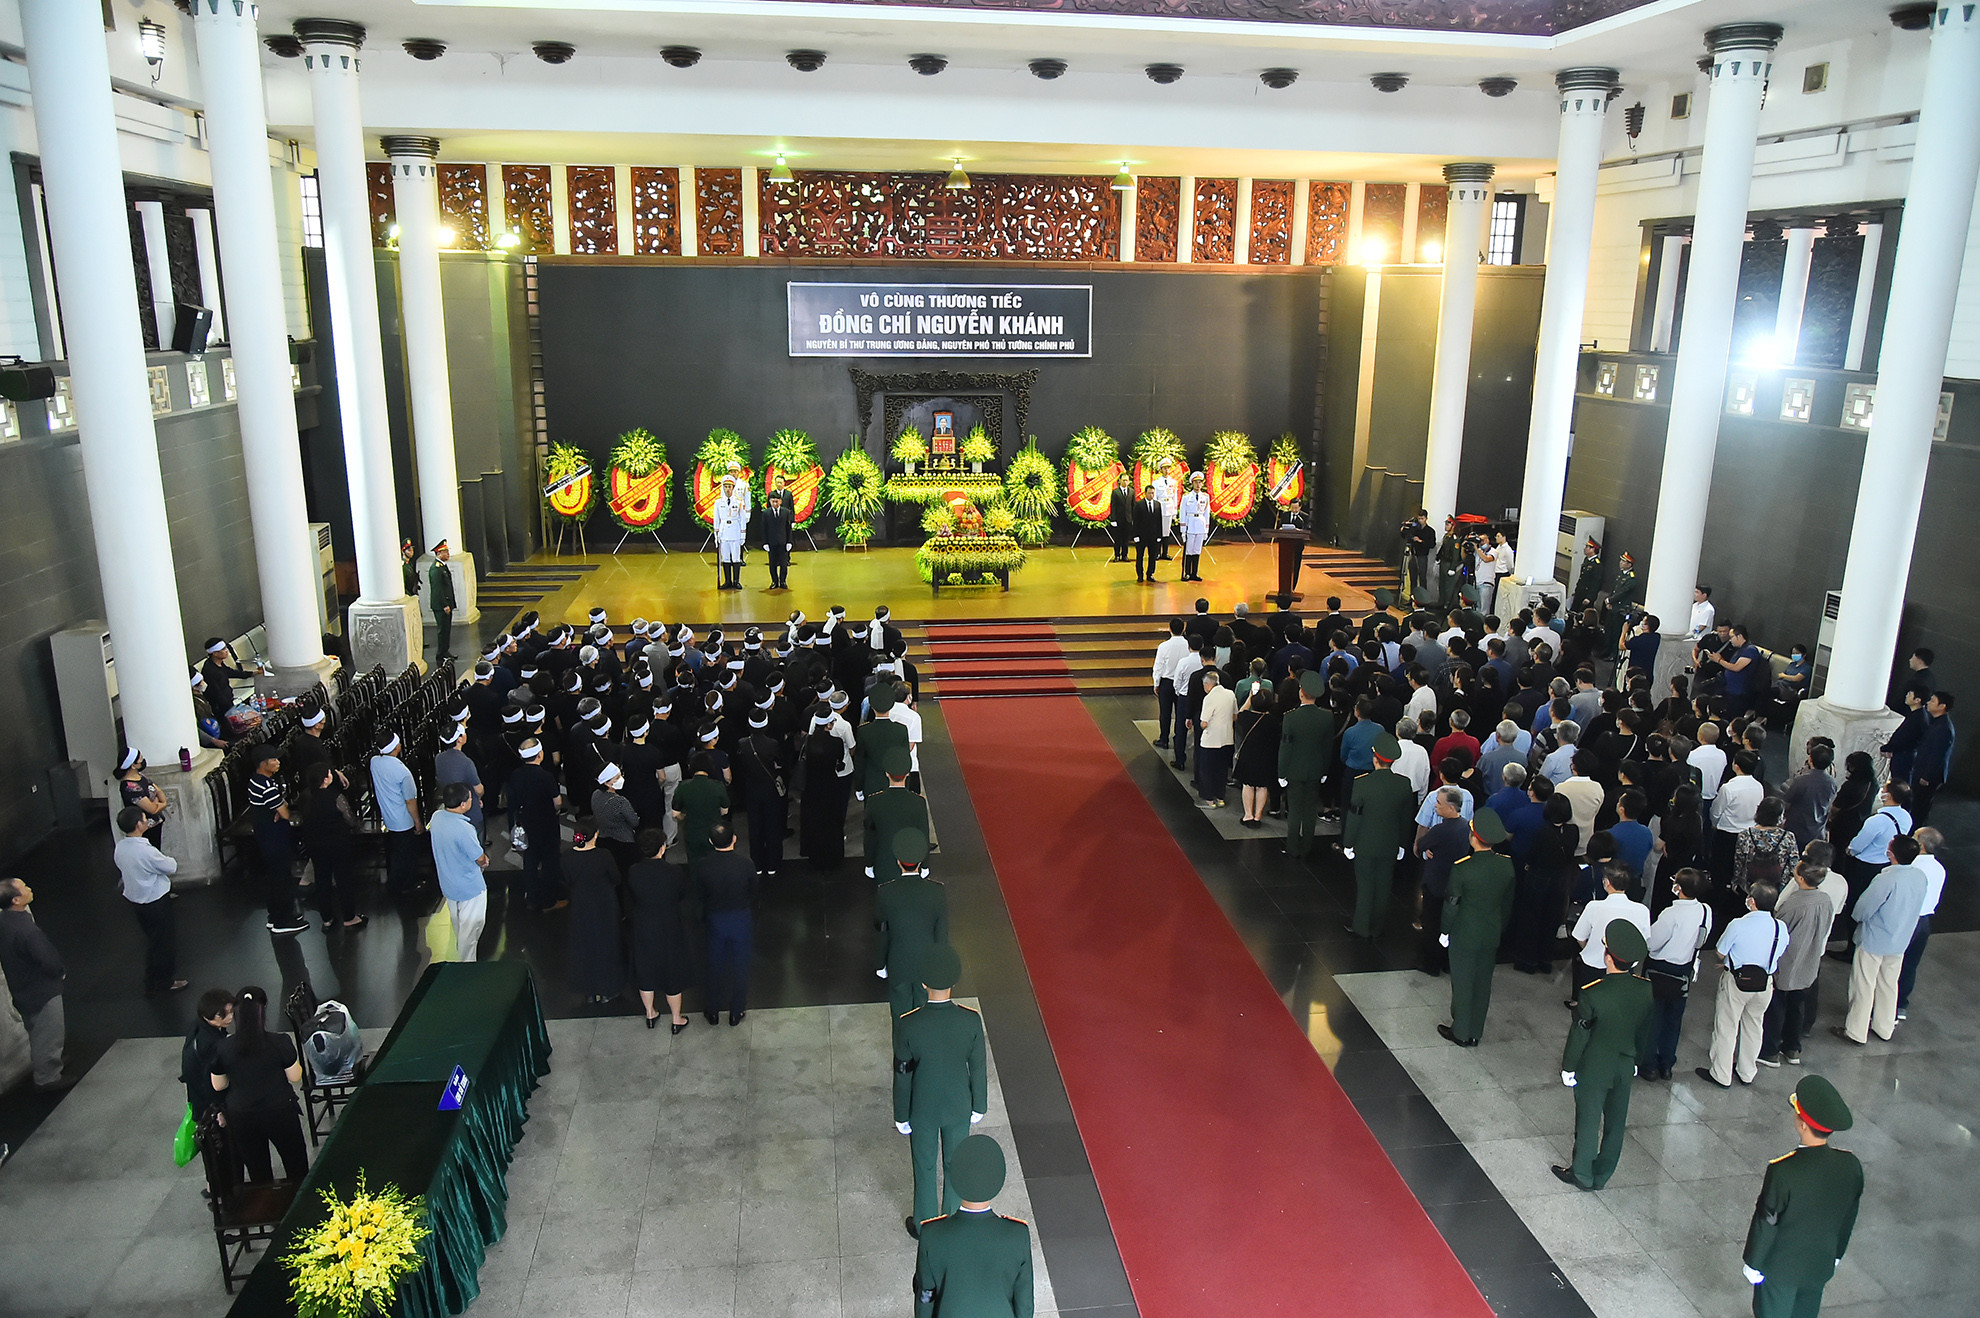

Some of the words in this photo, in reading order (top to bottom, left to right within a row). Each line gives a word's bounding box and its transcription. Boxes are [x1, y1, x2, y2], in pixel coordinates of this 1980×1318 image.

[860, 292, 879, 307] VÔ
[883, 292, 925, 308] CÙNG
[928, 294, 987, 308] THƯƠNG
[990, 292, 1023, 309] TIẾC
[819, 308, 873, 334] ĐỒNG
[879, 311, 911, 334] CHÍ
[917, 309, 994, 335] NGUYỄN
[999, 312, 1064, 335] KHÁNH
[806, 339, 838, 349] NGUYÊN
[840, 339, 848, 349] BÍ
[849, 339, 865, 349] THƯ
[866, 340, 892, 349] TRUNG
[893, 340, 915, 349] ƯƠNG
[941, 339, 973, 350] NGUYÊN
[974, 340, 990, 350] PHÓ
[991, 339, 1006, 350] THỦ
[1034, 340, 1058, 350] CHÍNH
[1059, 339, 1075, 350] PHỦ
